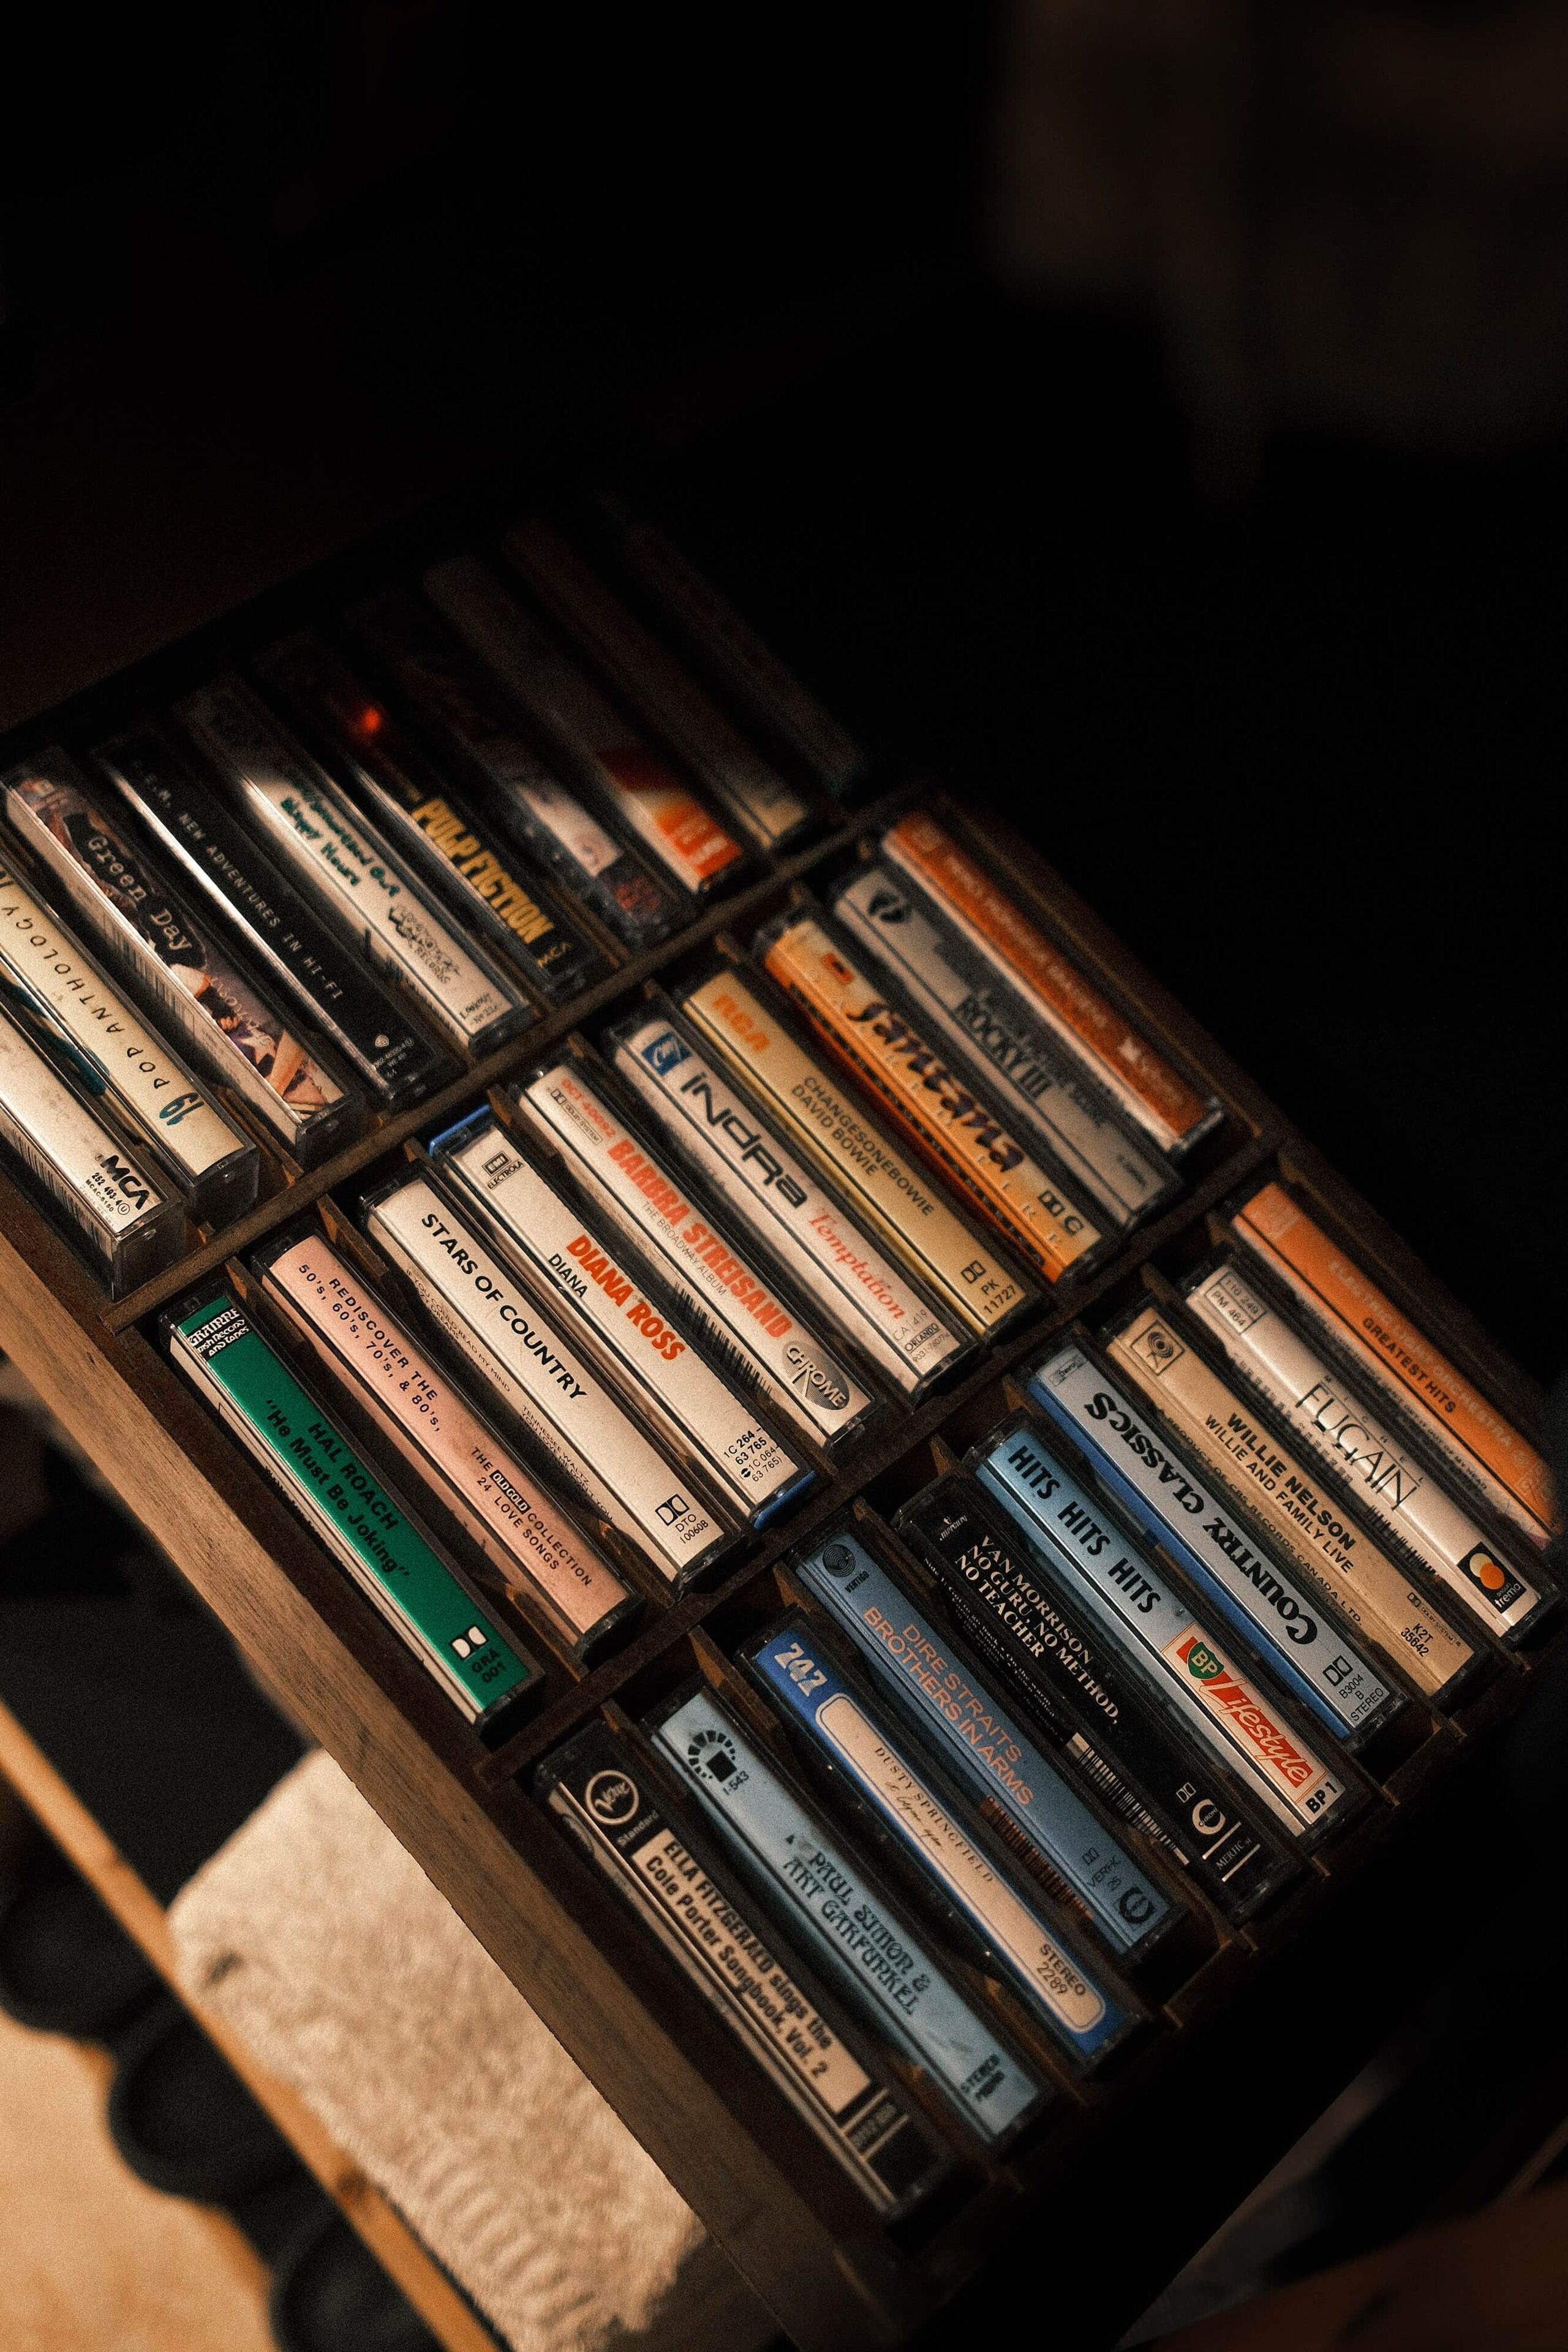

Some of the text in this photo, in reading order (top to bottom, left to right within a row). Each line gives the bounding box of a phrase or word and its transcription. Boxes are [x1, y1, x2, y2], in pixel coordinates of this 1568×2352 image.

[84, 832, 194, 957] Green Day
[176, 811, 344, 1001] NEW ADVENTURES IN HI-FI
[410, 793, 482, 867] PULP
[458, 846, 555, 948] FICTION
[1, 899, 126, 1040] ANTHOLOGY
[124, 1042, 170, 1092] POP
[710, 992, 773, 1056] RCA
[951, 993, 1055, 1102] ROCKY III
[484, 1153, 508, 1174] EMI
[579, 1099, 617, 1140] 40092
[790, 1084, 879, 1177] DAVID BOWIE
[801, 1074, 935, 1217] CHANGESONEBOWIE
[99, 1153, 154, 1210] MCA
[486, 1158, 524, 1192] ELECTROLA
[547, 1253, 590, 1298] DIANA
[606, 1137, 692, 1227] BARBRA
[680, 1221, 794, 1341] STREISAND
[640, 1200, 728, 1297] THE BROADWAY ALBUM
[805, 1207, 908, 1321] Temptation
[979, 1277, 1000, 1297] PK
[328, 1277, 439, 1403] REDISCOVER THE
[420, 1211, 479, 1277] STARS
[471, 1272, 504, 1306] OF
[496, 1302, 588, 1405] COUNTRY
[565, 1233, 636, 1307] DIANA
[625, 1300, 687, 1364] ROSS
[902, 1321, 940, 1355] ORLANDO
[981, 1283, 1018, 1317] 11727
[1210, 1290, 1230, 1310] PM
[296, 1262, 445, 1434] 50's, 60's, 70's, & 80's,
[783, 1345, 846, 1408] CHROME
[1360, 1316, 1458, 1415] GREATEST HITS
[733, 1436, 768, 1467] 63 765
[734, 1429, 756, 1450] 264
[1081, 1387, 1207, 1517] CLASSICS
[1292, 1382, 1419, 1512] FUGAIN
[1430, 1363, 1513, 1449] ORCHESTRA
[288, 1436, 332, 1486] Must
[325, 1483, 353, 1512] Be
[306, 1421, 399, 1531] HAL ROACH
[469, 1446, 593, 1587] THE OLD GOLD COLLECTION
[749, 1469, 764, 1483] 63
[1202, 1414, 1249, 1462] WILLIE
[1245, 1460, 1278, 1493] AND
[1274, 1490, 1325, 1542] FAMILY
[1321, 1540, 1355, 1574] LIVE
[1224, 1412, 1288, 1479] WILLIE
[1283, 1475, 1358, 1552] NELSON
[475, 1476, 493, 1493] 24
[492, 1495, 524, 1529] LOVE
[521, 1528, 561, 1572] SONGS
[1006, 1444, 1164, 1616] HITS HITS HITS
[1212, 1467, 1228, 1483] OF
[1227, 1483, 1250, 1504] CBS
[1248, 1504, 1296, 1555] RECORDS
[1296, 1554, 1340, 1599] CANADA
[843, 1570, 870, 1594] VERTIGO
[953, 1553, 982, 1583] NO
[975, 1578, 1047, 1659] TEACHER
[978, 1534, 1016, 1575] VAN
[1011, 1572, 1095, 1667] MORRISON
[1202, 1514, 1324, 1651] COUNTRY
[1492, 1581, 1524, 1610] trema
[469, 1647, 500, 1675] GRA
[480, 1659, 507, 1684] 001
[773, 1640, 829, 1698] 747
[966, 1544, 1126, 1727] NO GURU, NO METHOD,
[1398, 1626, 1430, 1659] 35642
[1412, 1622, 1434, 1645] K2T
[861, 1606, 963, 1723] BROTHERS
[956, 1717, 982, 1743] IN
[976, 1740, 1036, 1807] ARMS
[900, 1623, 949, 1675] DIRE
[941, 1671, 1023, 1764] STRAITS
[1189, 1649, 1311, 1784] BP Lifestyle
[1337, 1673, 1366, 1700] B3004
[1349, 1686, 1385, 1723] STEREO
[873, 1746, 994, 1884] DUSTY SPRINGFIELD
[1303, 1787, 1331, 1815] BP
[807, 1850, 933, 1994] PAUL SIMON &
[1106, 1874, 1123, 1892] 25
[644, 1853, 830, 2079] Cole Porter Songbook, Vol. 2
[662, 1840, 838, 2051] ELLA FITZGERALD sings the
[782, 1855, 824, 1901] ART
[818, 1896, 923, 2016] GARFUNKEL
[1035, 1961, 1069, 1997] 2289
[1038, 1942, 1088, 1998] STEREO
